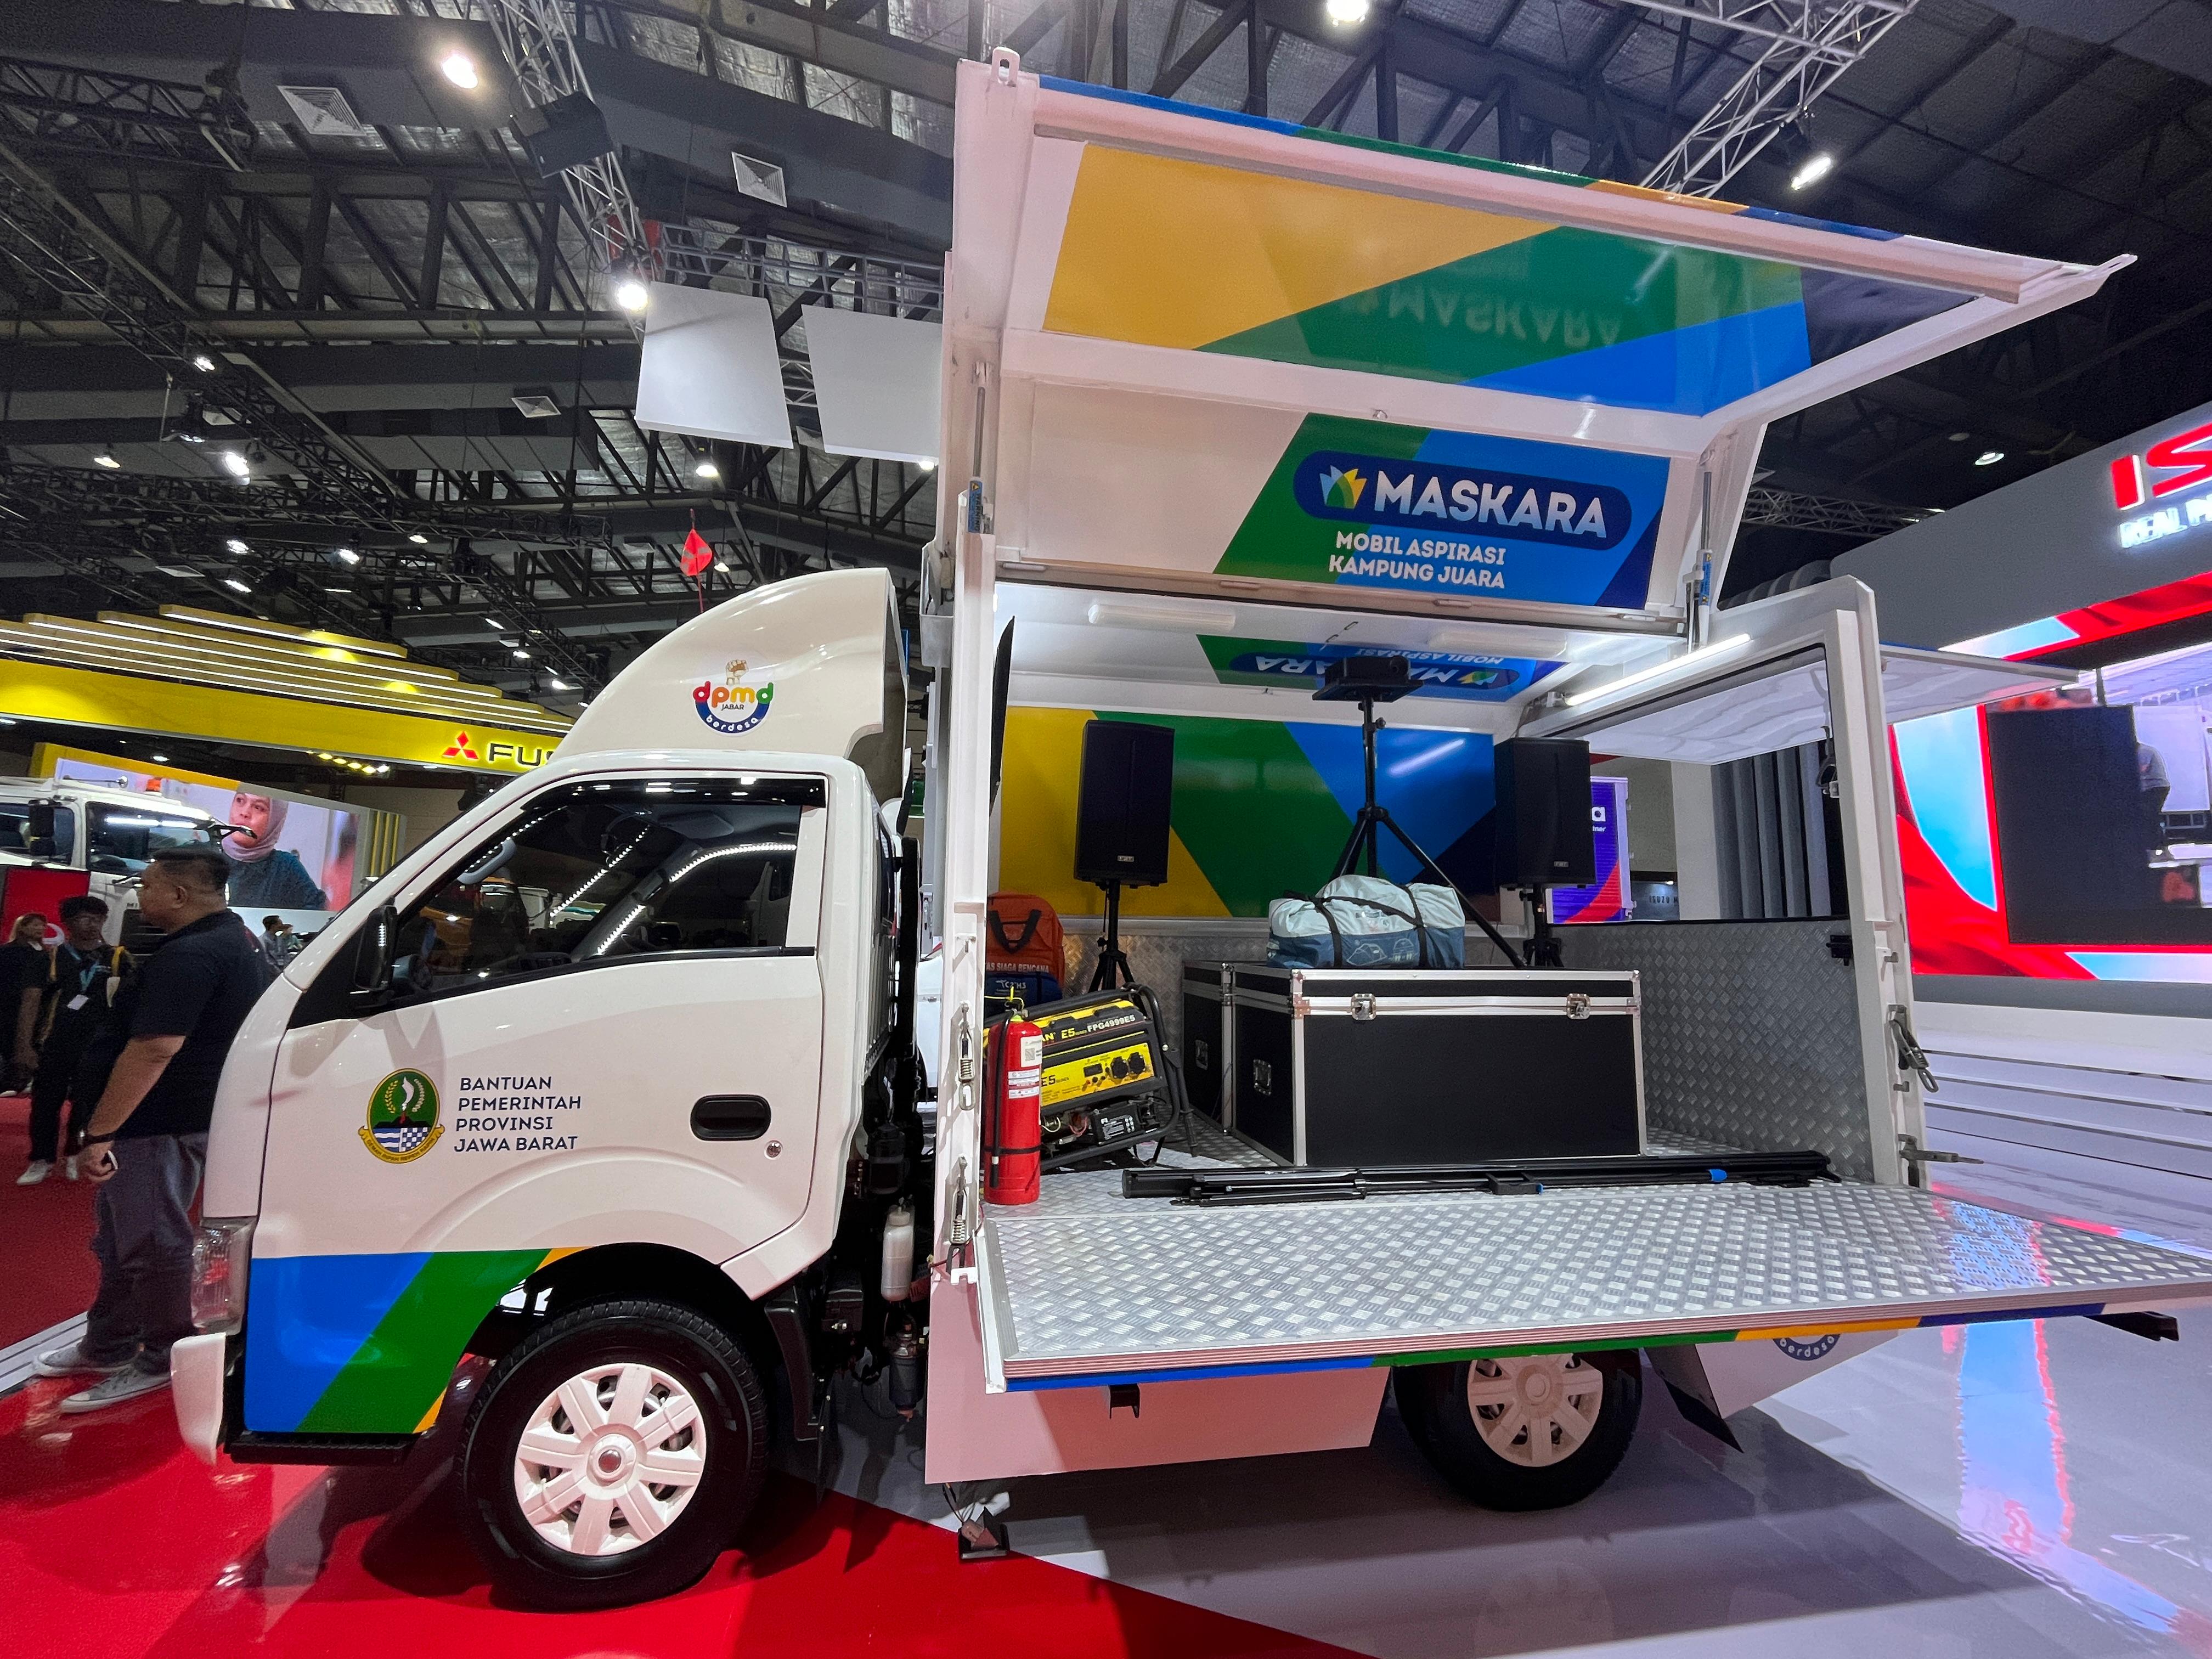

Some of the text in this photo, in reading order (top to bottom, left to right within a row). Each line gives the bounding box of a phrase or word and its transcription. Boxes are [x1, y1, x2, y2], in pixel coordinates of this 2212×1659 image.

[1374, 470, 1607, 538] MASKARA
[1336, 531, 1505, 565] MOBIL ASPIRASI
[1329, 555, 1505, 589] KAMPUNG JUARA
[692, 680, 774, 708] dpmd
[721, 703, 744, 711] JABAR
[706, 714, 759, 732] berdesa
[488, 742, 554, 766] FU
[986, 962, 1049, 973] AS SIAGA BENCANA
[460, 1076, 551, 1091] BANTUAN
[458, 1096, 581, 1111] PEMERINTAH
[456, 1116, 553, 1132] PROVINSI
[454, 1136, 578, 1152] JAWA BARAT
